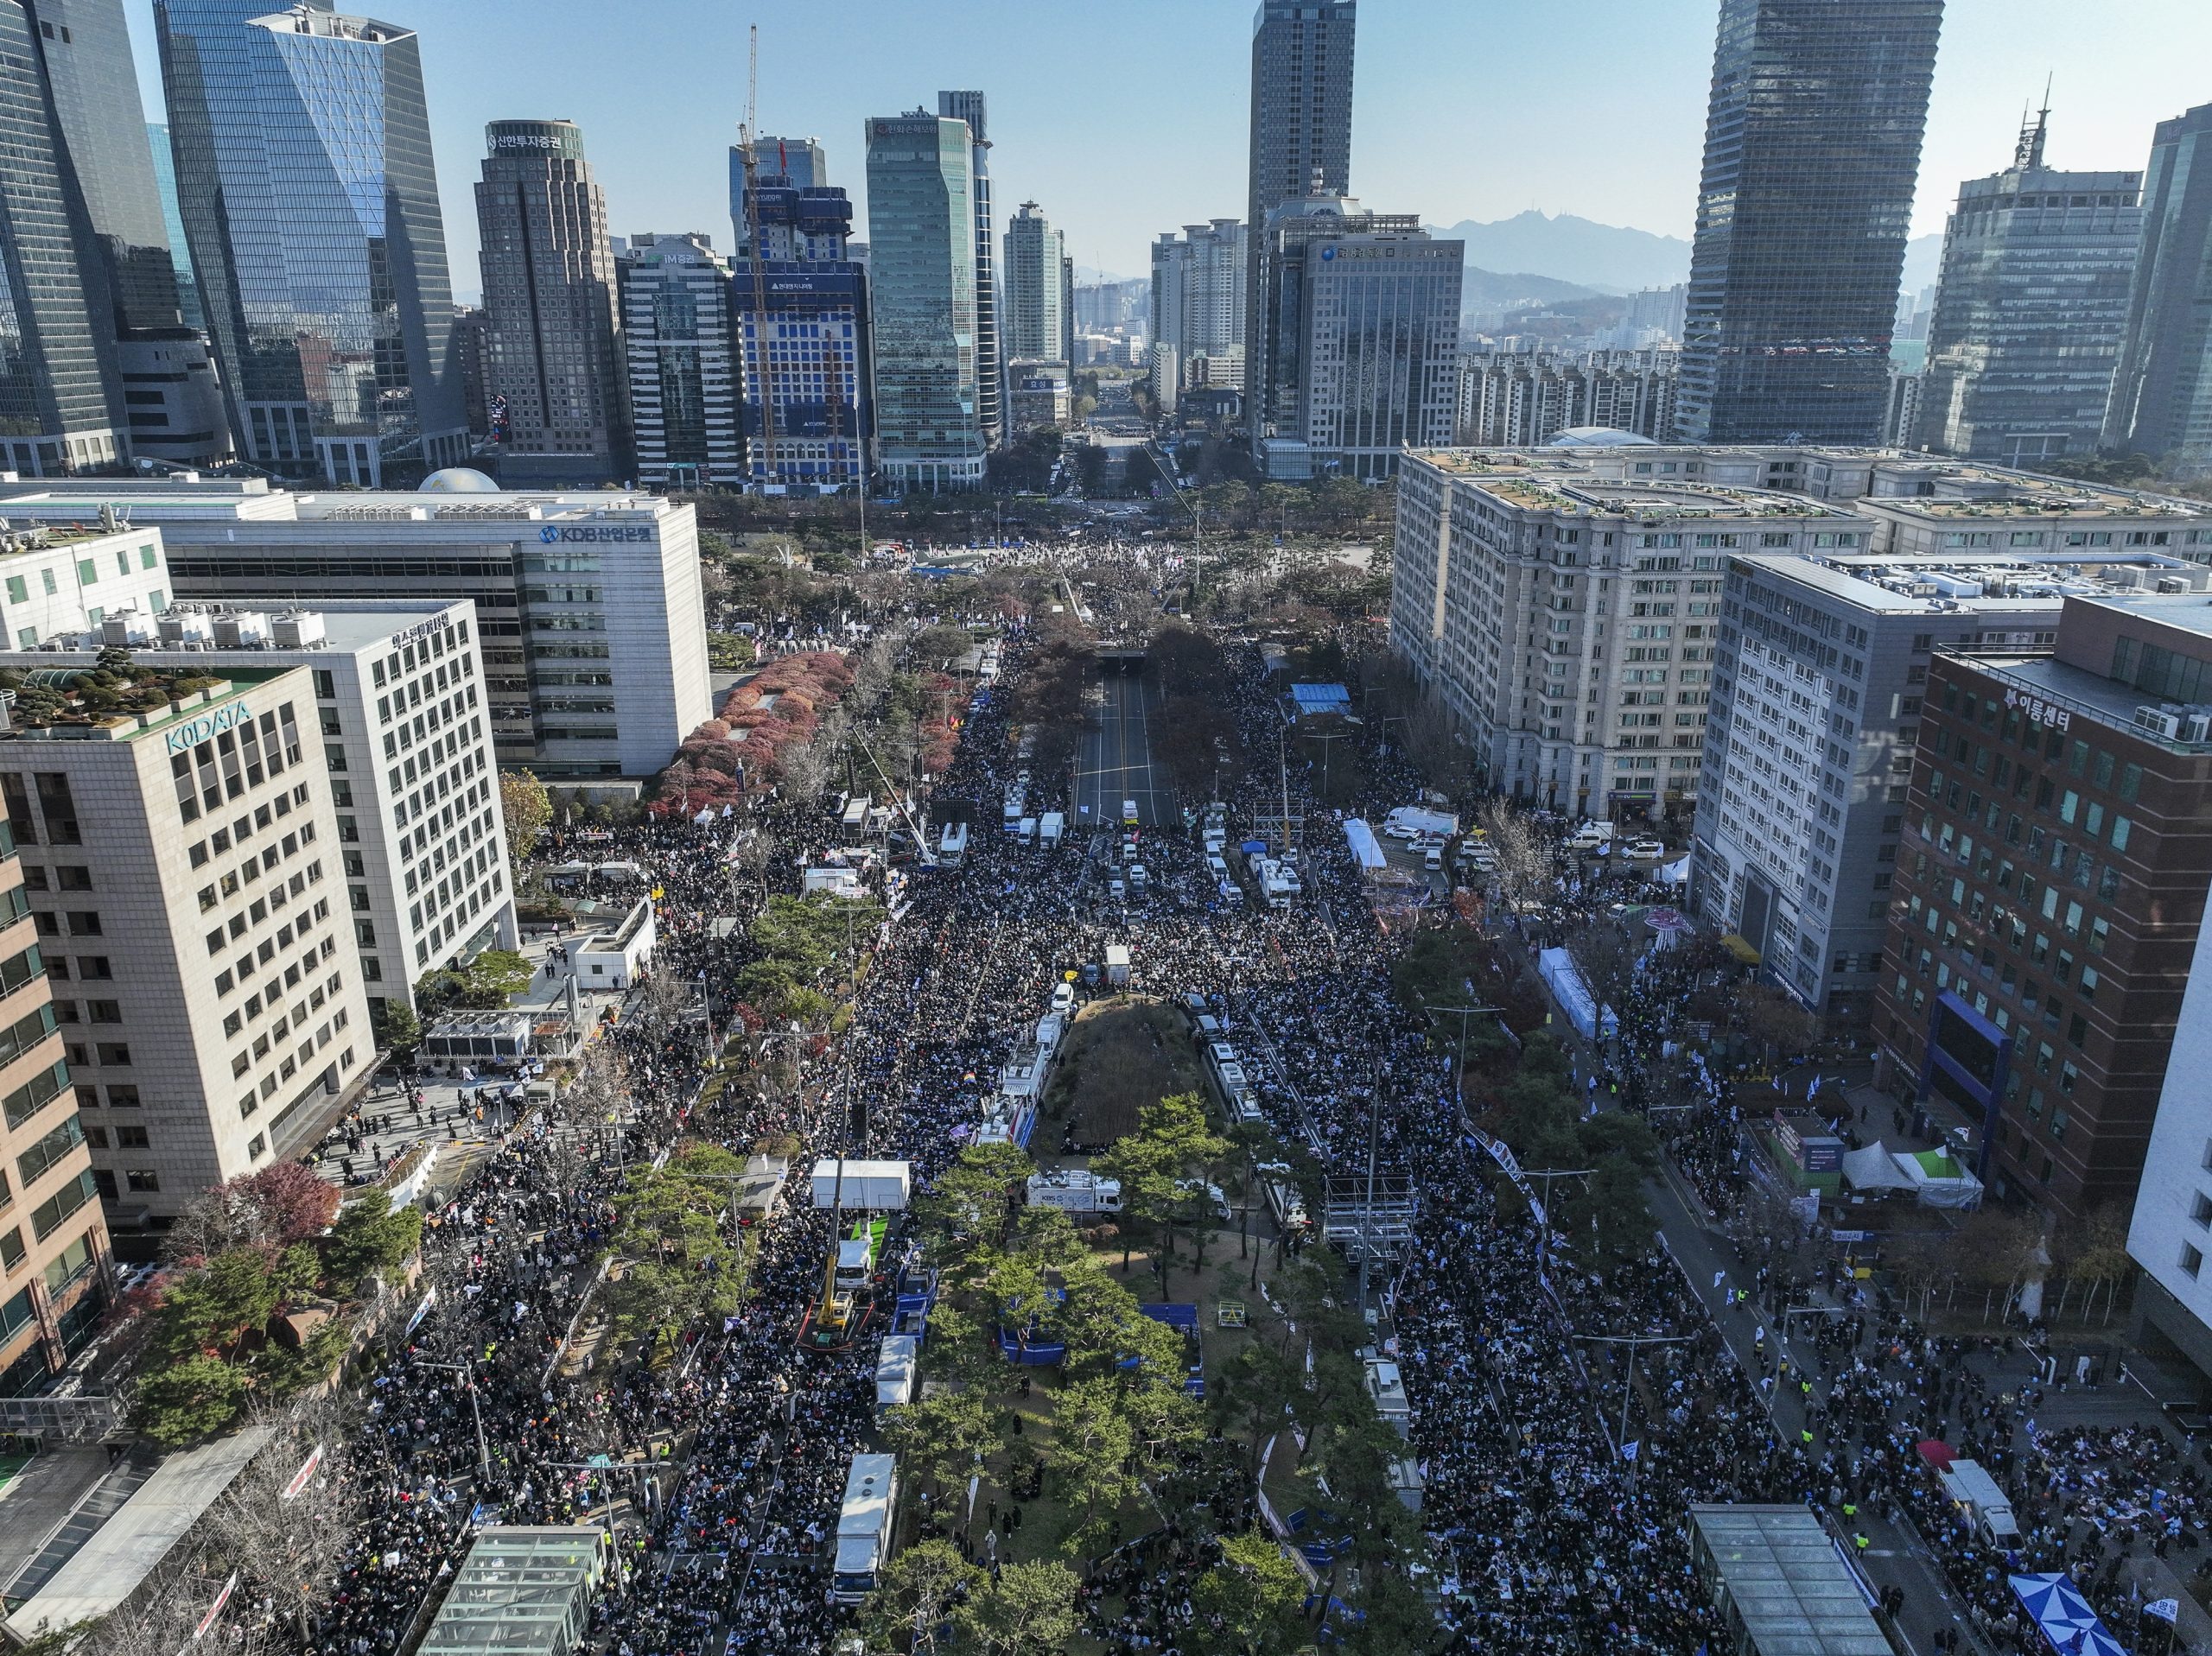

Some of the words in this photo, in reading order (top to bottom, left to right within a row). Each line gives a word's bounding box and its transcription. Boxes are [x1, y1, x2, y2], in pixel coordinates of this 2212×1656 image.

[887, 124, 937, 134] 한화손해보험
[498, 136, 561, 149] 신한투자증권
[664, 254, 695, 264] iM증권
[1031, 380, 1046, 389] 효성
[561, 527, 652, 543] KDB산업은행
[2019, 695, 2070, 732] 이룸센터
[165, 700, 252, 757] KODATA
